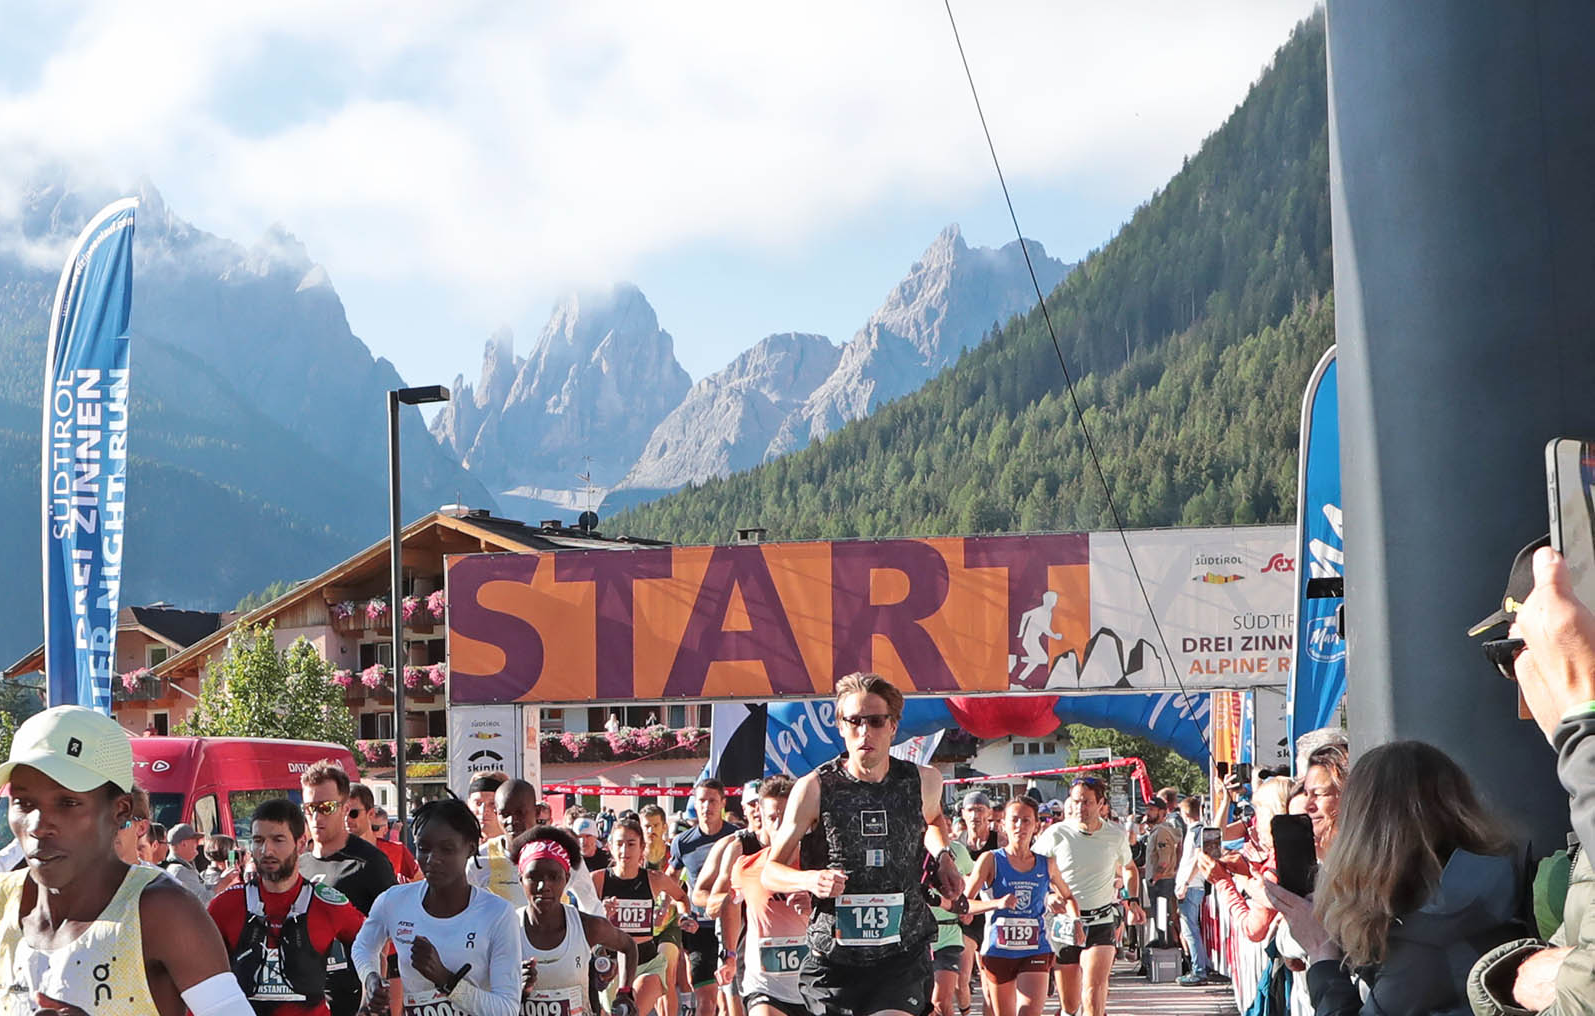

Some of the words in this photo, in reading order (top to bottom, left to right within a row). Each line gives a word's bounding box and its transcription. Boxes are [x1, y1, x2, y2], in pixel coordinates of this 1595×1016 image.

[108, 368, 130, 460] RUN
[49, 369, 75, 540] SÜDTIROL
[70, 368, 102, 534] ZINNEN
[71, 549, 93, 650] DREI
[449, 533, 1090, 703] START
[1182, 637, 1233, 653] DREI
[1240, 635, 1294, 651] ZINN
[1188, 656, 1269, 675] ALPINE
[467, 763, 504, 772] skinfit
[616, 908, 646, 923] 1013
[852, 907, 890, 929] 143
[862, 930, 881, 939] NILS
[1002, 926, 1033, 941] 1139
[777, 950, 800, 970] 16
